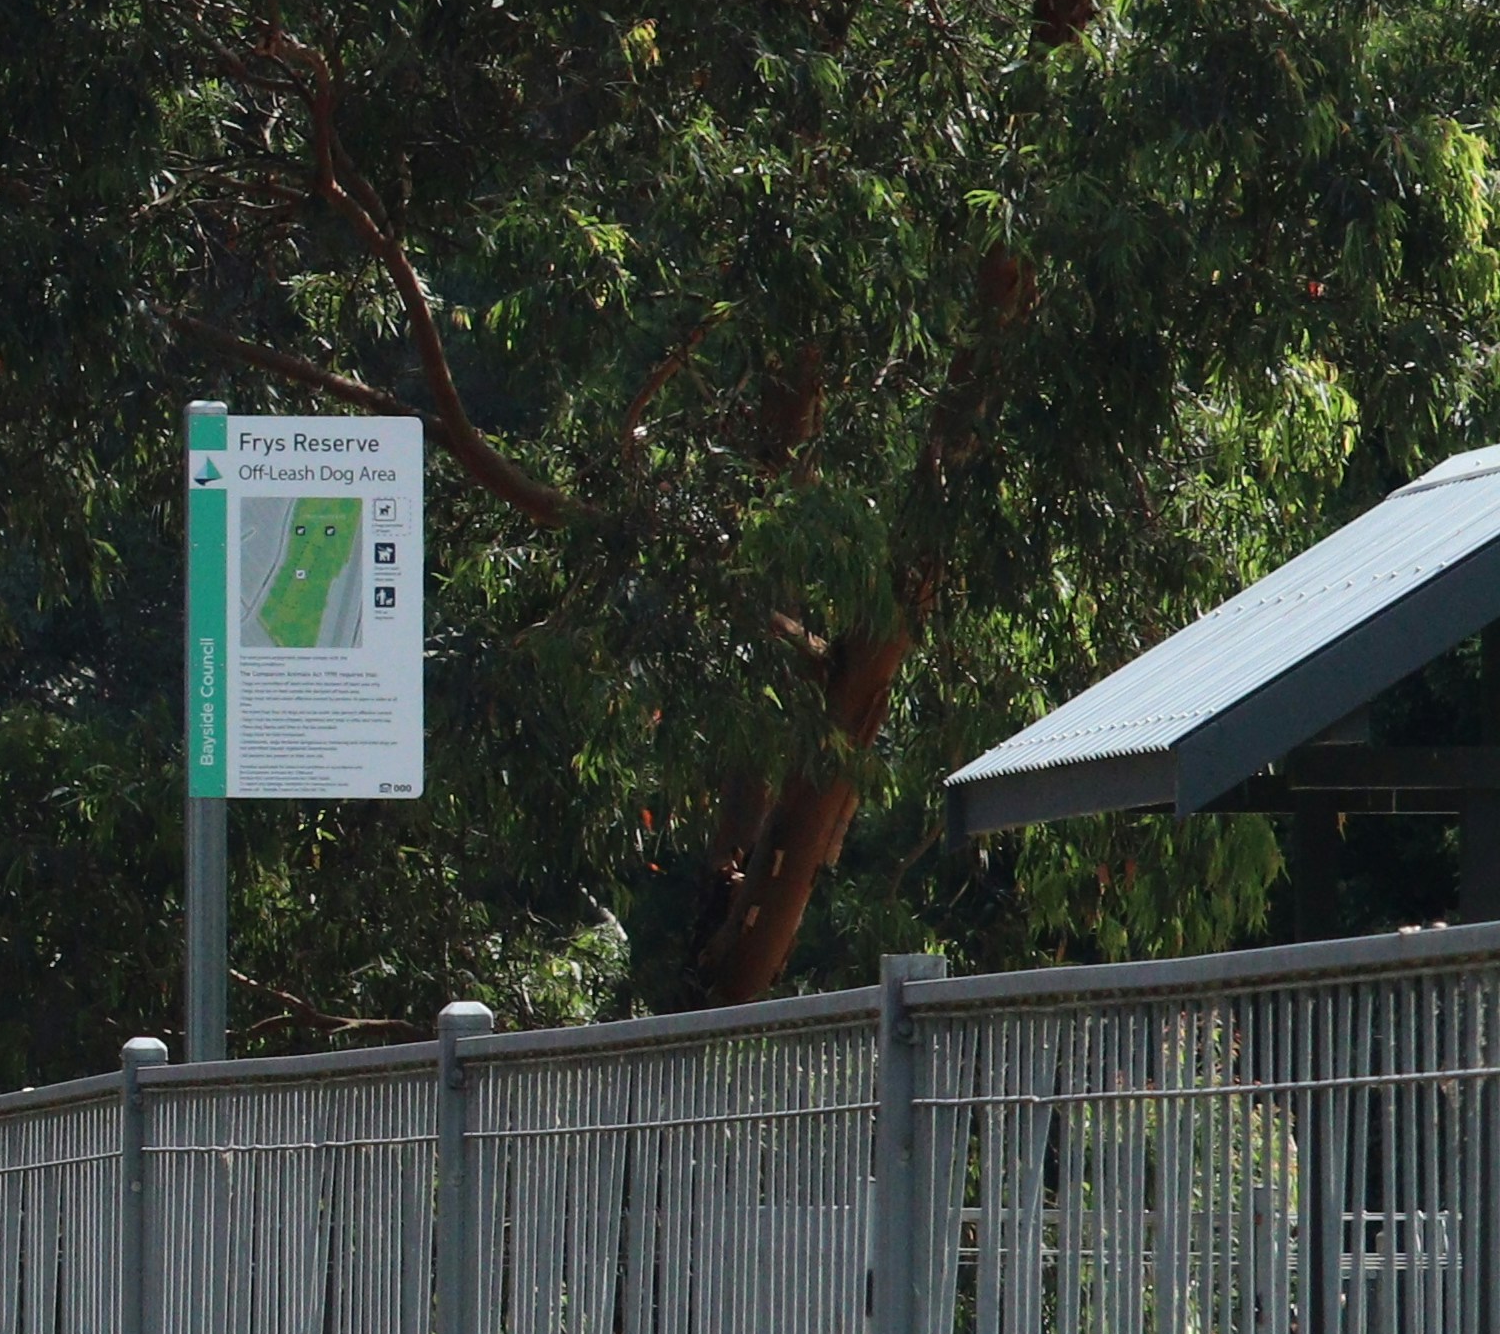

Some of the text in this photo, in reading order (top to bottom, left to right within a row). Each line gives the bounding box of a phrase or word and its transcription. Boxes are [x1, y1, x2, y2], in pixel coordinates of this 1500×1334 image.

[240, 433, 379, 456] Frys Reserve
[239, 464, 396, 485] Off-Leash Dog Area
[200, 637, 217, 766] Bayside Council
[393, 784, 412, 793] 000
